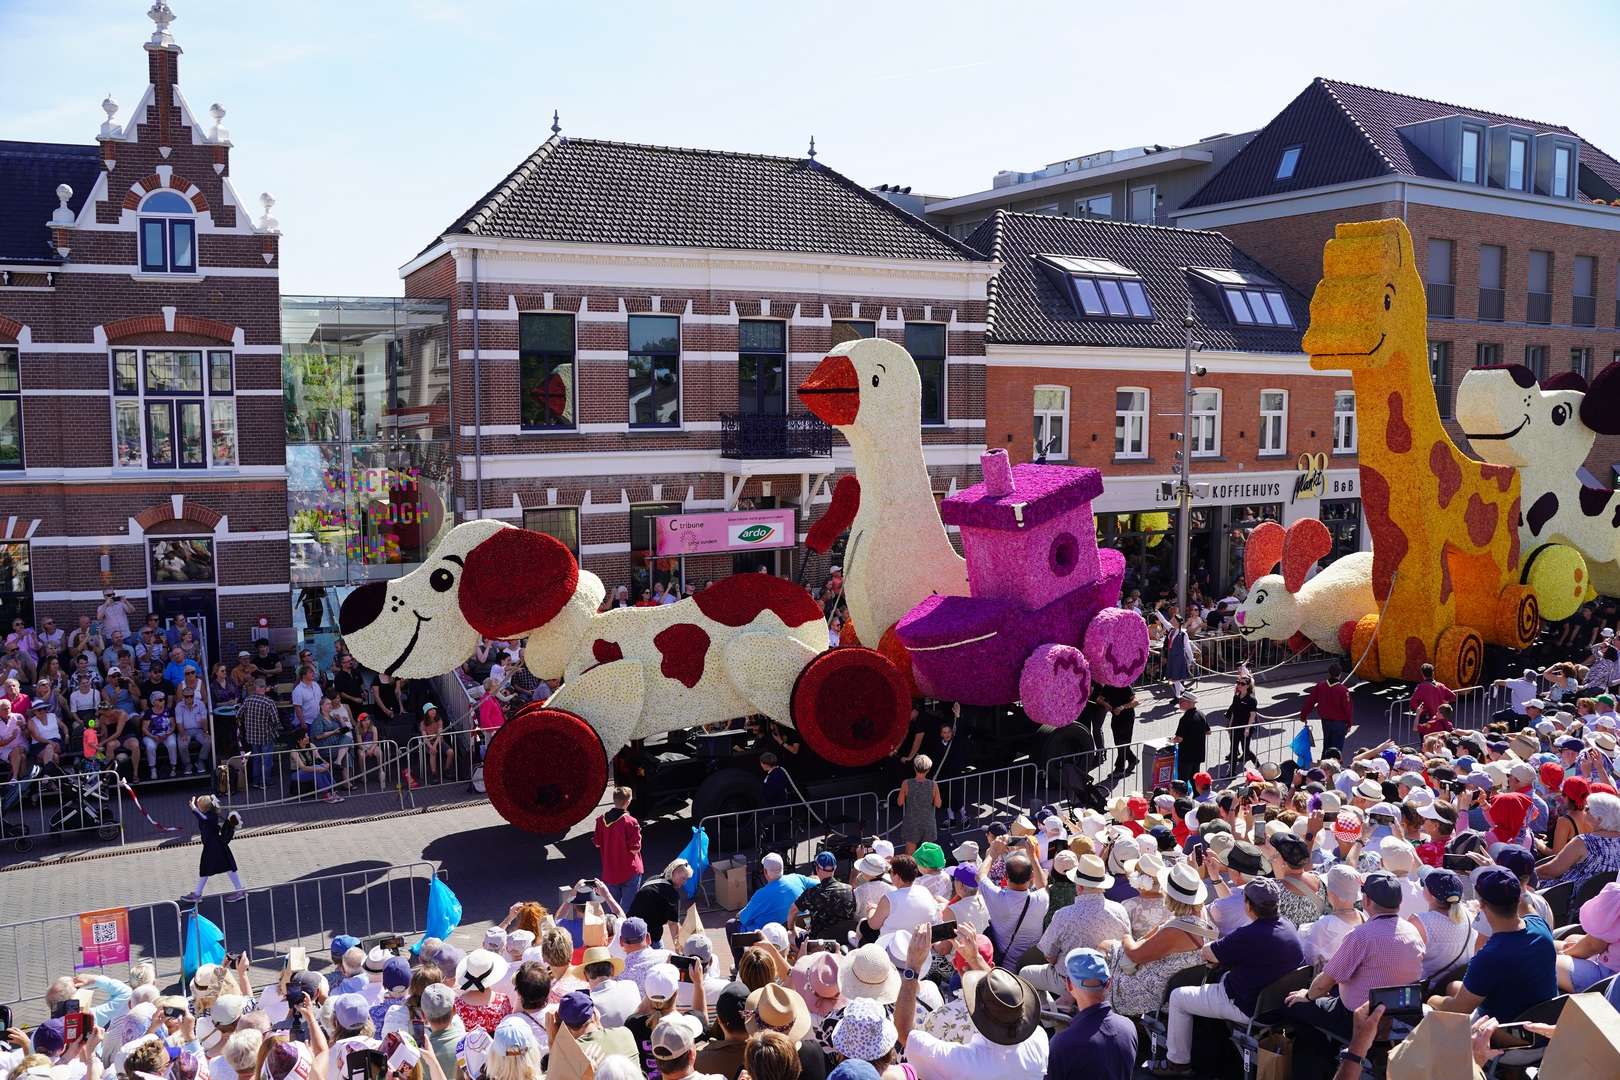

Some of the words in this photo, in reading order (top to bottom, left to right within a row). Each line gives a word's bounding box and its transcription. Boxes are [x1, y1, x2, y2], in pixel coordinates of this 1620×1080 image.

[324, 469, 420, 493] VINCENT
[1212, 482, 1281, 499] KOFFIEHUYS
[317, 503, 360, 526] VAN
[370, 502, 428, 525] GOGH
[669, 519, 678, 531] C
[680, 521, 704, 530] tribune
[742, 527, 767, 538] ardo
[347, 535, 401, 559] HUIS
[700, 538, 718, 546] zundert
